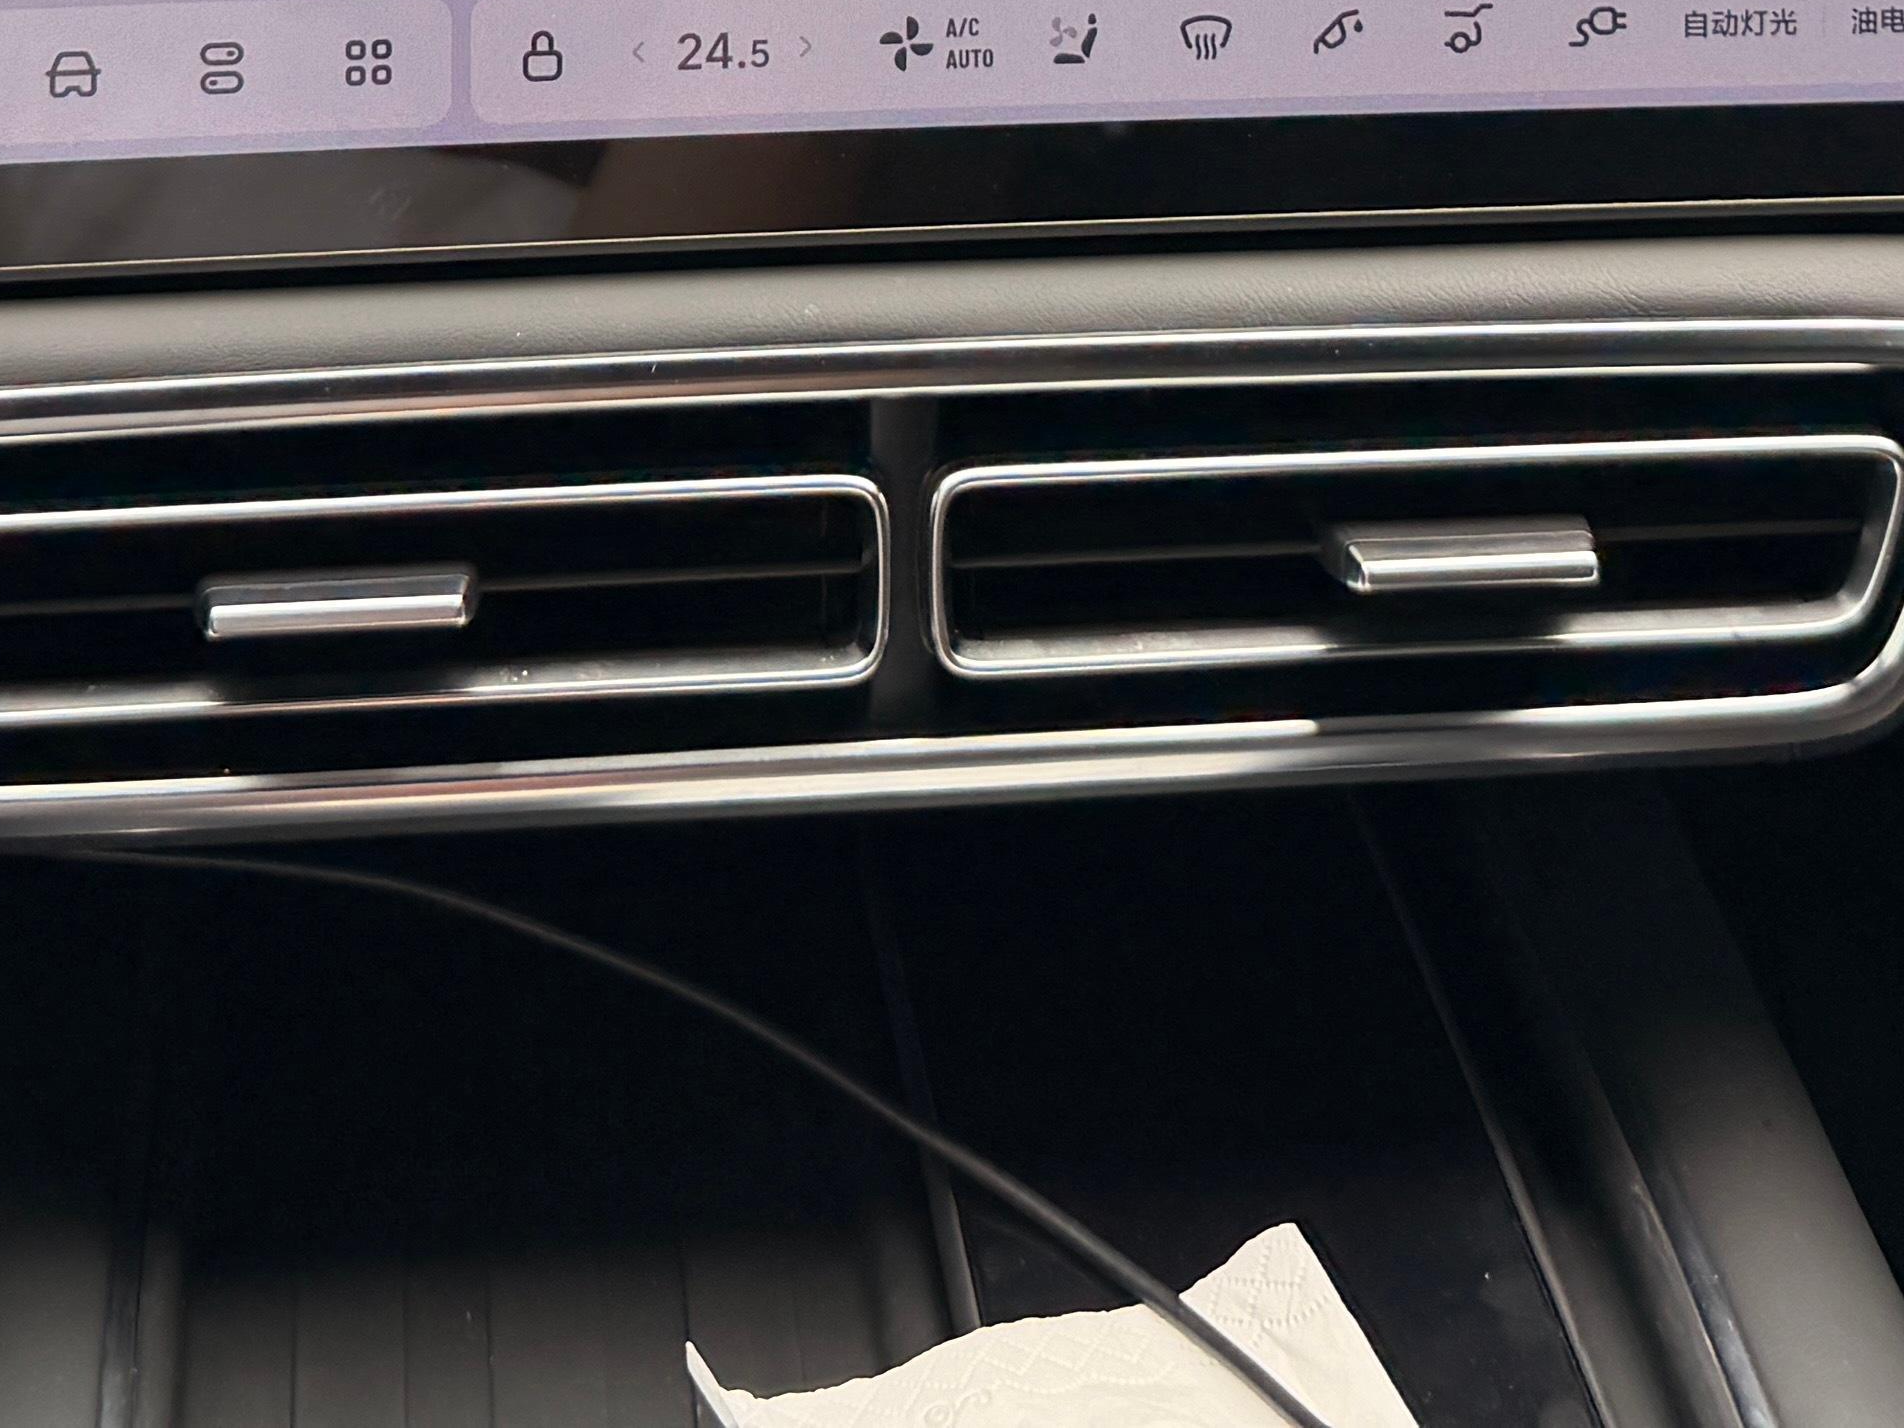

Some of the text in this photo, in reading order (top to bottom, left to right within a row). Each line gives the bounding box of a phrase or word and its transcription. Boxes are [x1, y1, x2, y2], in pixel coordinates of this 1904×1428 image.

[945, 16, 981, 39] A/C
[1683, 7, 1799, 38] 自动灯光
[676, 31, 771, 72] 24.5
[945, 46, 995, 71] AUTO
